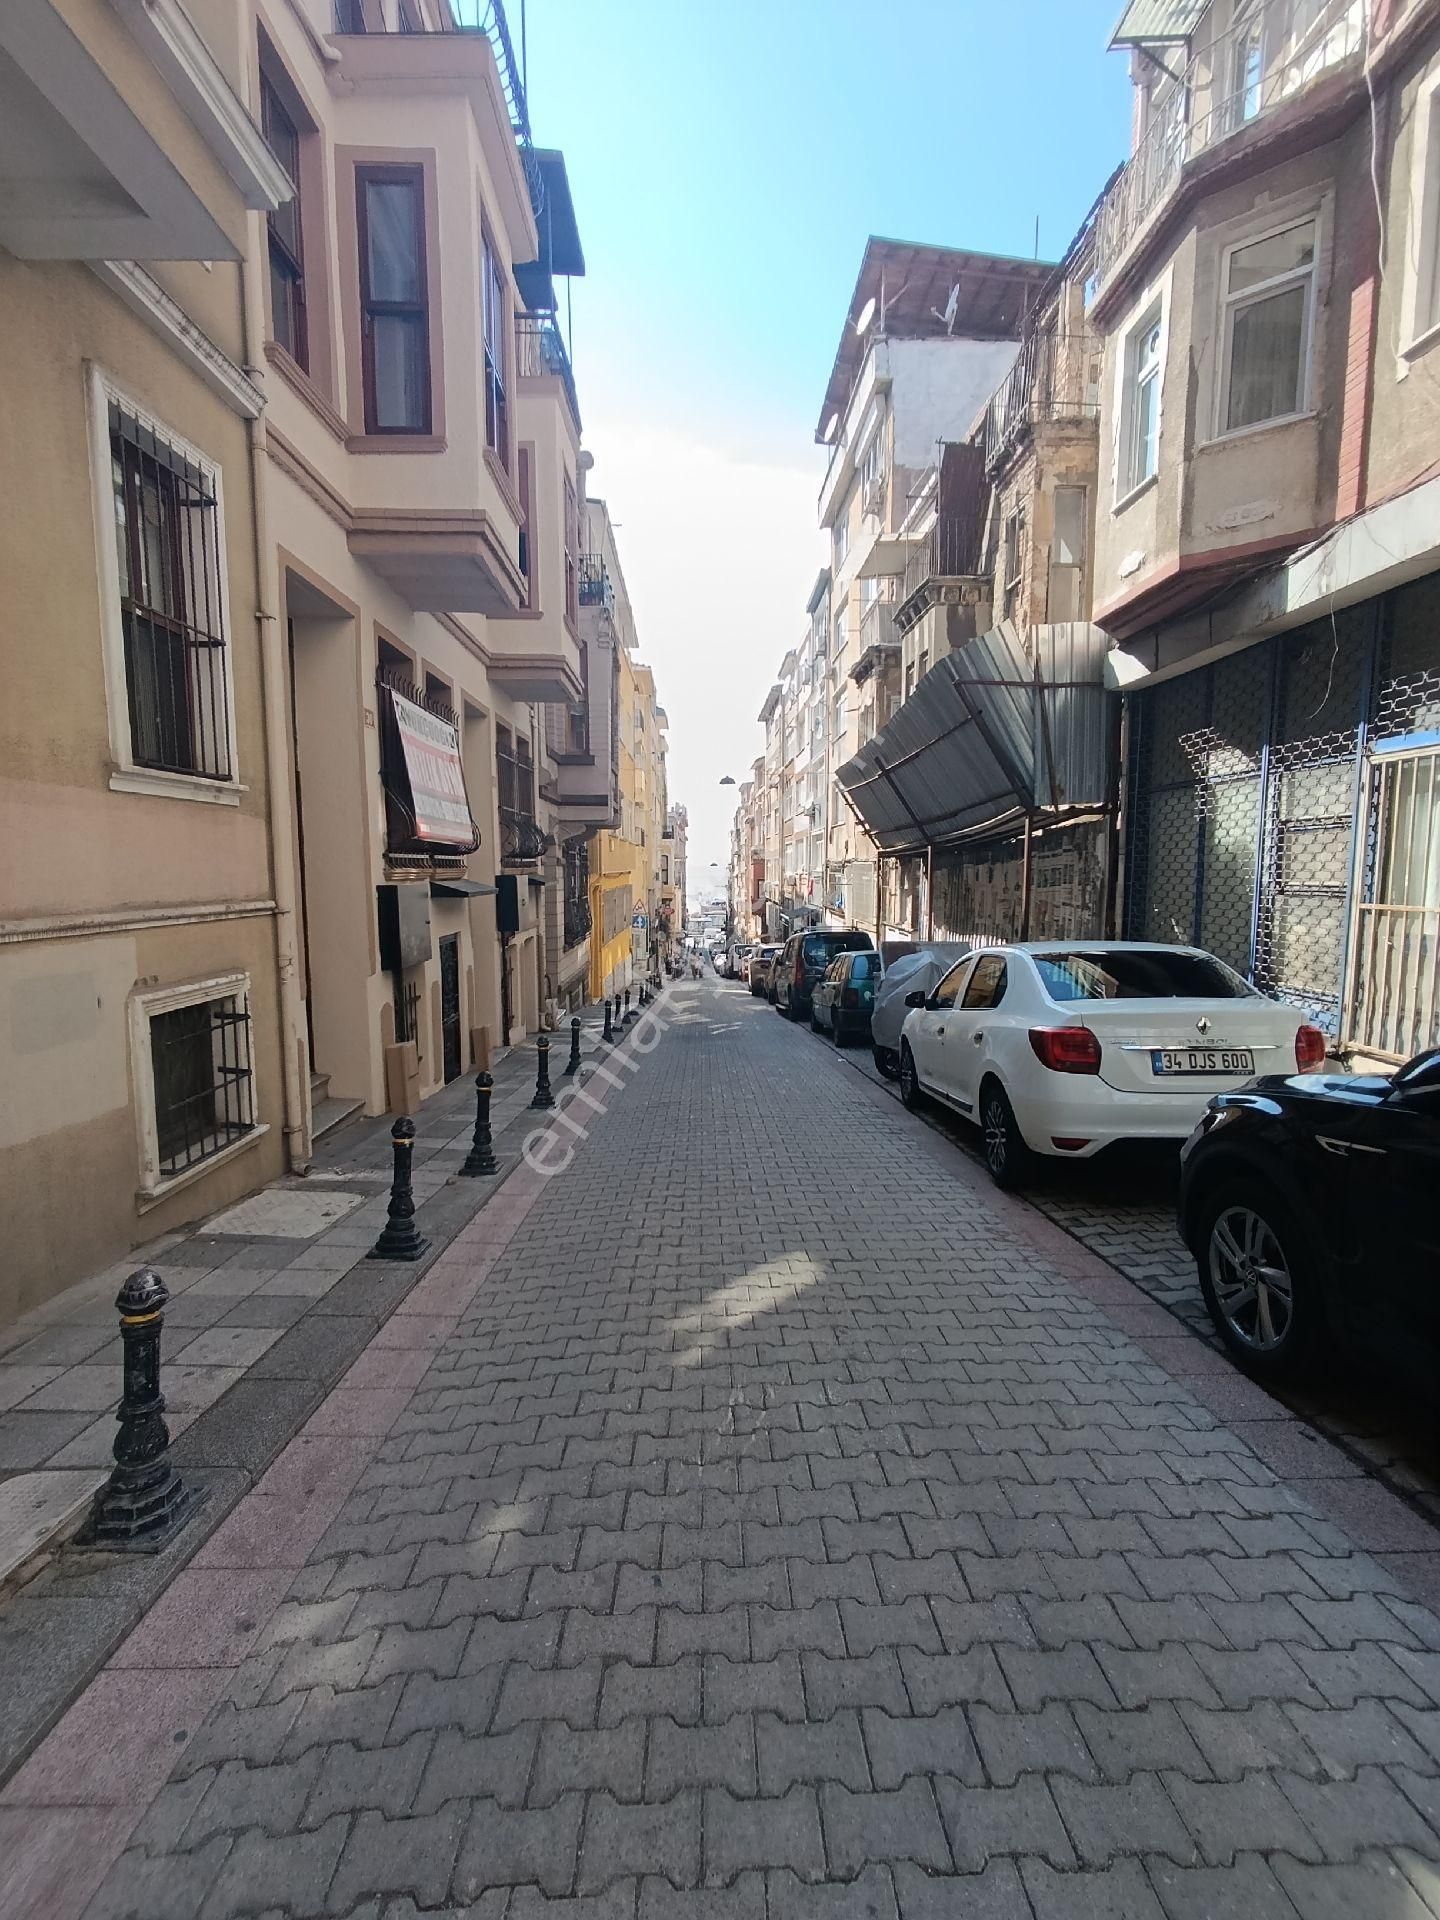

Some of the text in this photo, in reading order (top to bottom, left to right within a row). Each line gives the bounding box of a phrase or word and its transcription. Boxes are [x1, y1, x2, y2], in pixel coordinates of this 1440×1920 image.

[1163, 1053, 1249, 1069] 34 DJS 600
